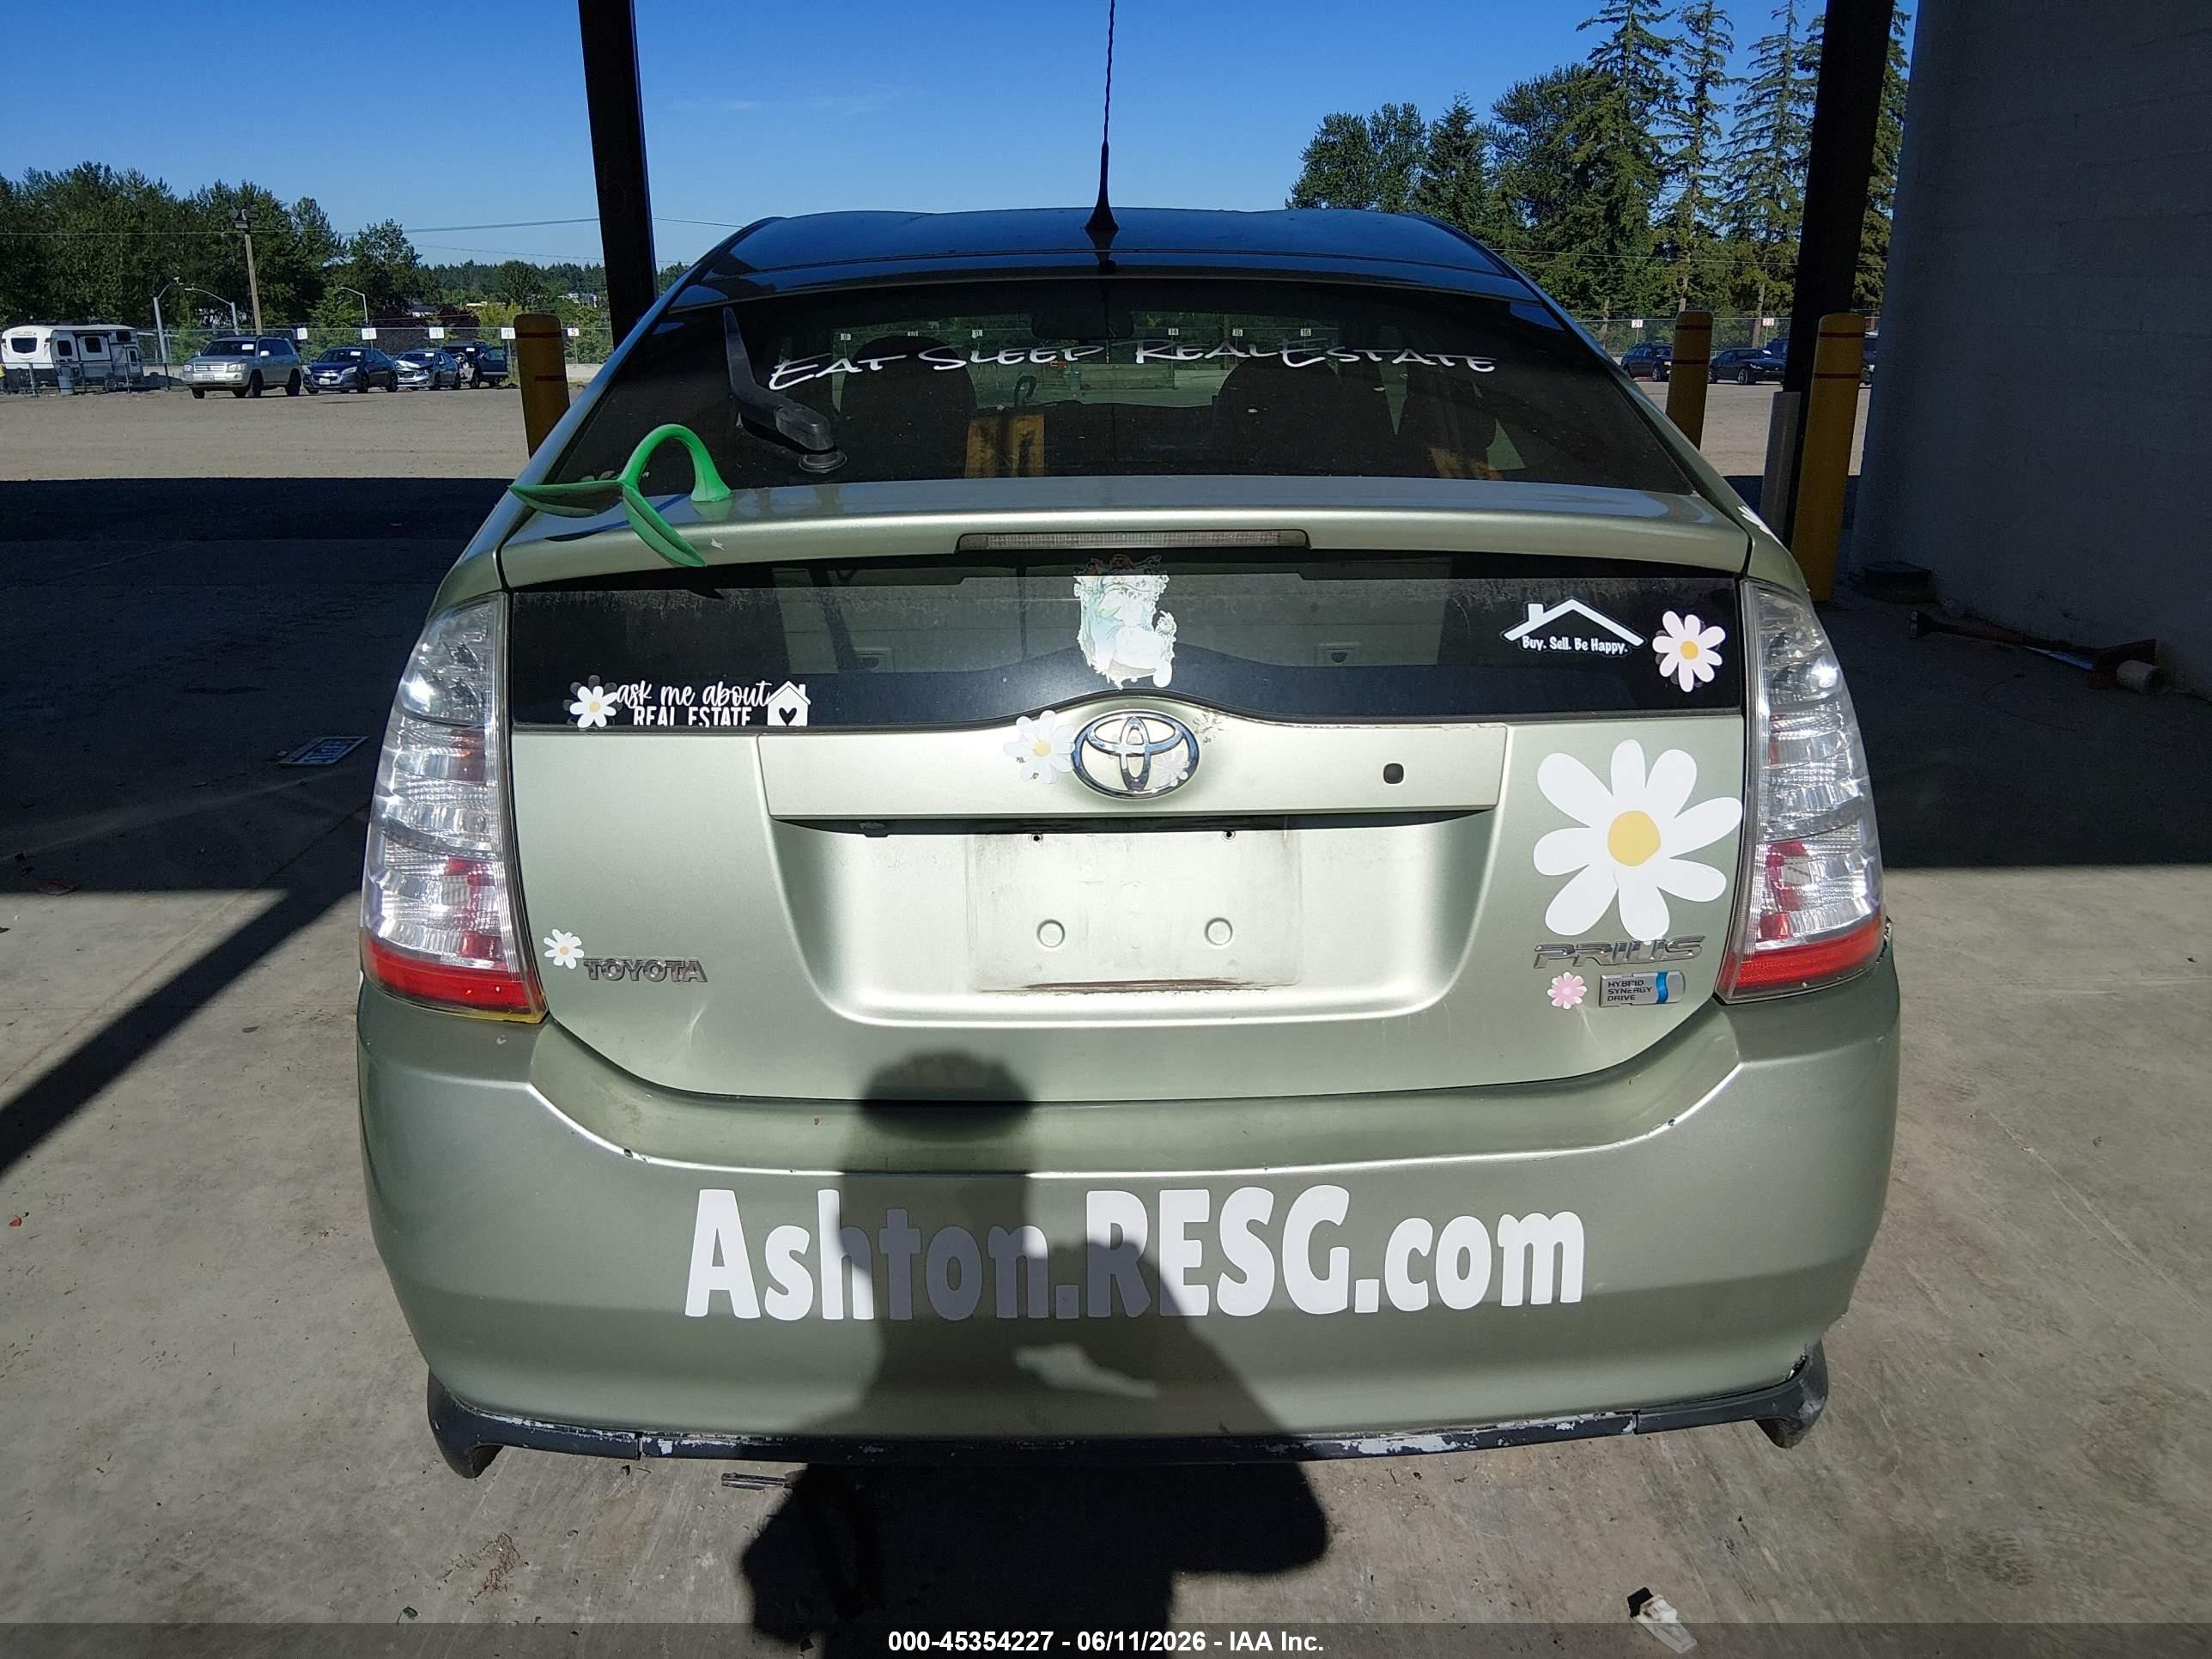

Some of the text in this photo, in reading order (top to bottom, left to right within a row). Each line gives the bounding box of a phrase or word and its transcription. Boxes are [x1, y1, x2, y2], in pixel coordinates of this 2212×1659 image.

[769, 353, 907, 390] EAT
[918, 344, 1105, 371] SLEEP
[1522, 635, 1628, 654] Buy. Sell. Be Happy.
[617, 680, 773, 708] ask me about
[1534, 935, 1705, 969] PRIUS
[584, 957, 708, 982] TOYOTA
[684, 1184, 1585, 1322] Ashton.RESG.com
